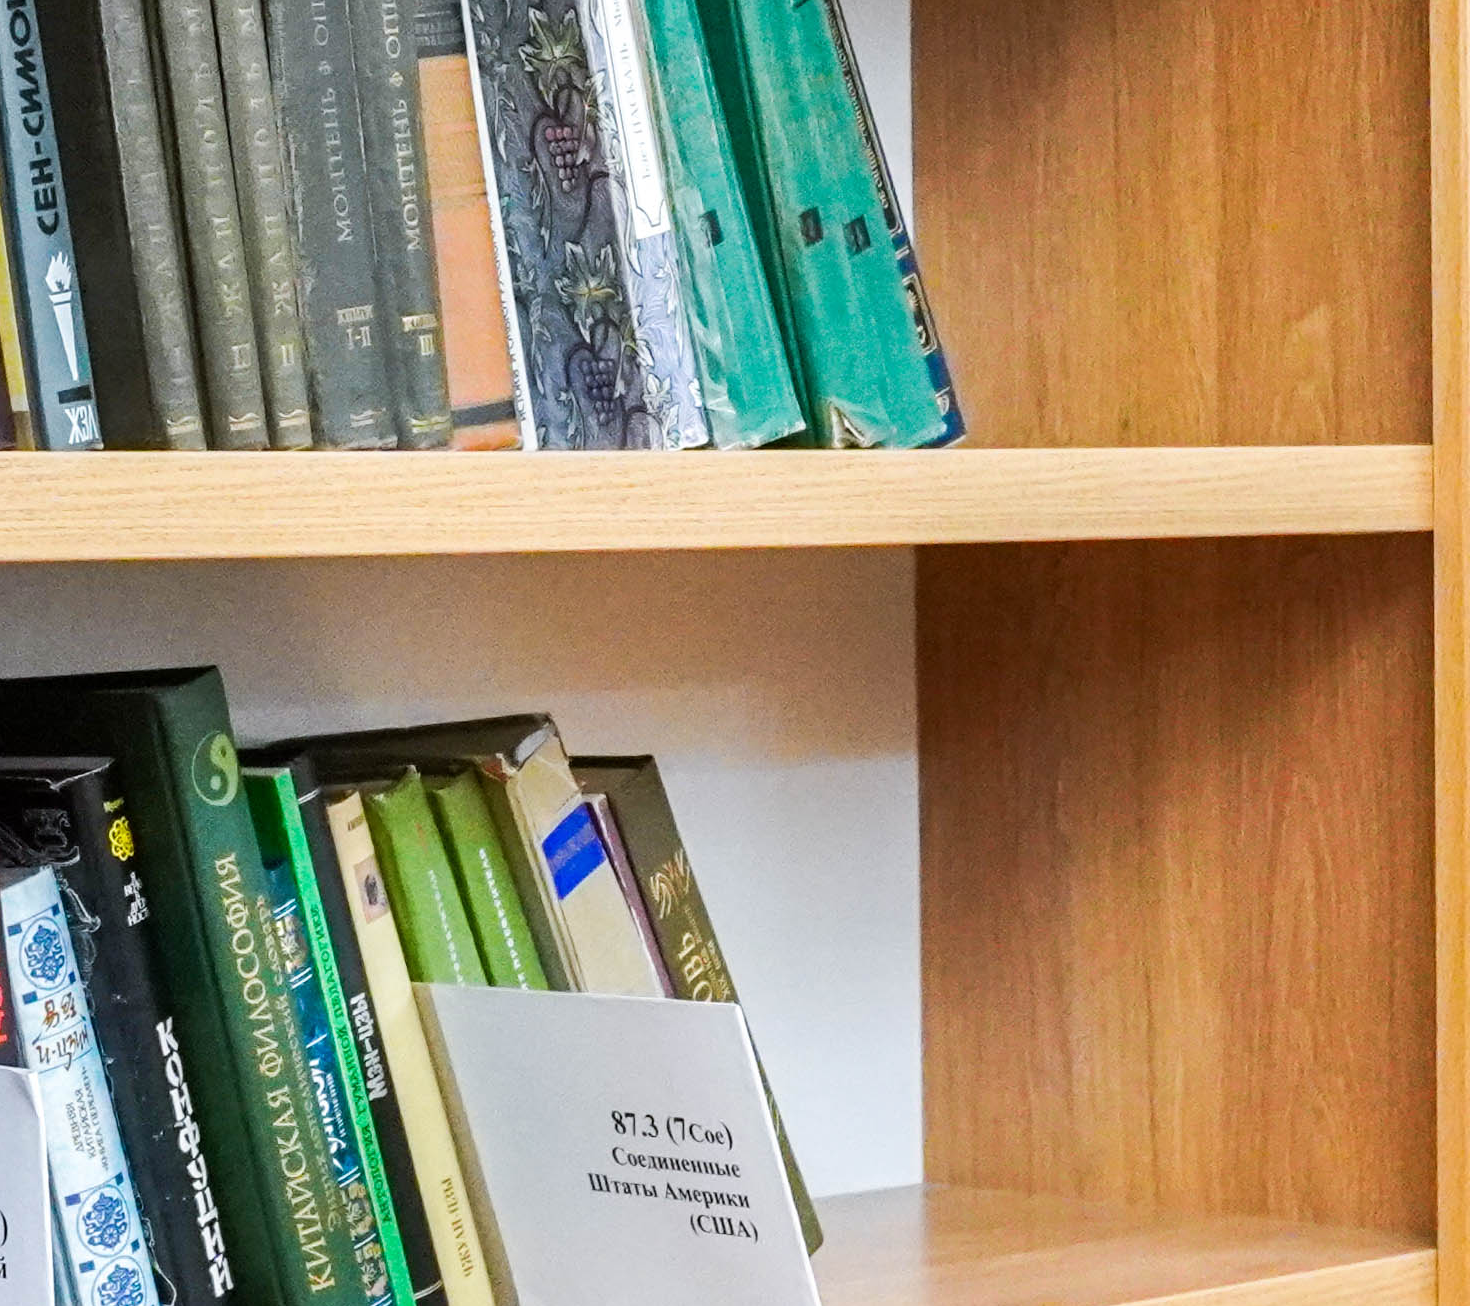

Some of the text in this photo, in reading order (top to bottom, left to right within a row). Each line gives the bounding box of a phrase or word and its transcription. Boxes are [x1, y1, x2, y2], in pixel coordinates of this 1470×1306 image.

[316, 86, 356, 245] МОНТЕНЬ
[396, 98, 421, 253] МОНТЕНЬ
[65, 405, 99, 445] ЖЗЛ
[214, 851, 338, 1293] КИТАЙСКАЯ ФИЛОСОФИЯ
[610, 1110, 733, 1151] 87.3 (7Сое)
[154, 1017, 233, 1298] КОНФУЦИЙ
[611, 1146, 742, 1180] Соединенные
[587, 1172, 750, 1210] Штаты Америки
[690, 1212, 760, 1243] (США)
